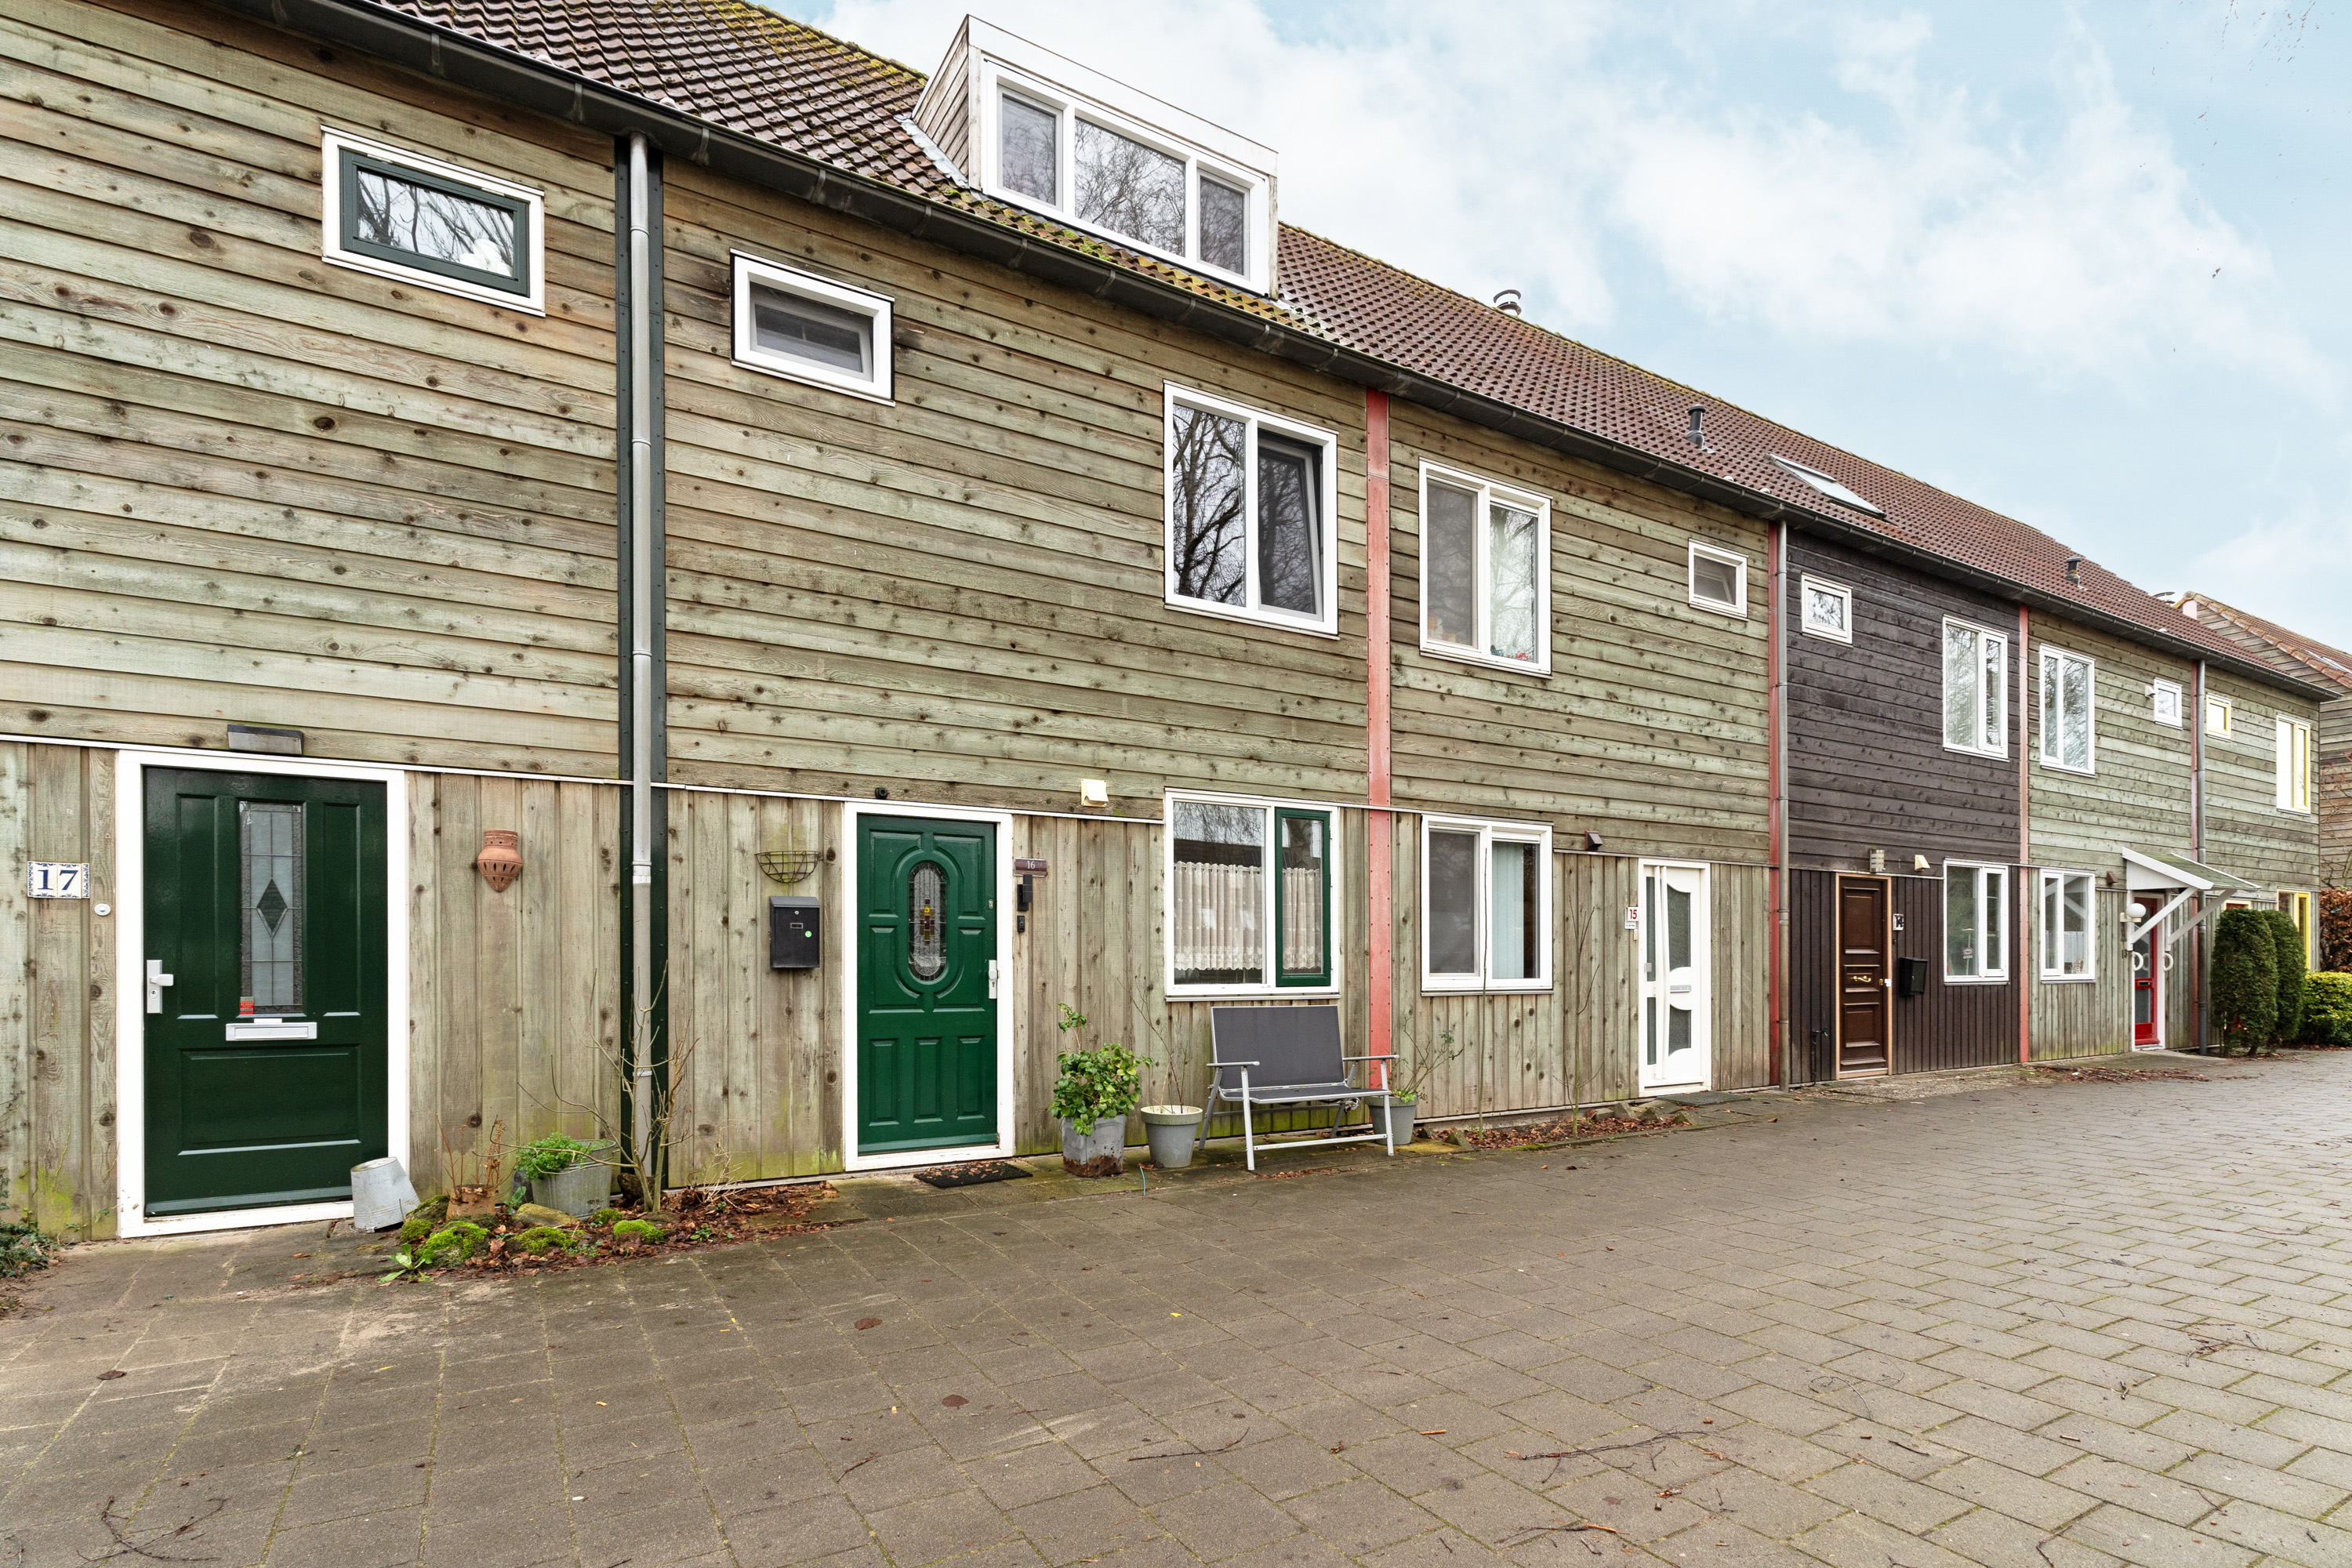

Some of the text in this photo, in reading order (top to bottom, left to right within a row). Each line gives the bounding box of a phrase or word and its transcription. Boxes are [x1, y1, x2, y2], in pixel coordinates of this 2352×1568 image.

[1027, 860, 1036, 869] 16
[37, 869, 78, 891] 17
[1629, 909, 1638, 920] 15
